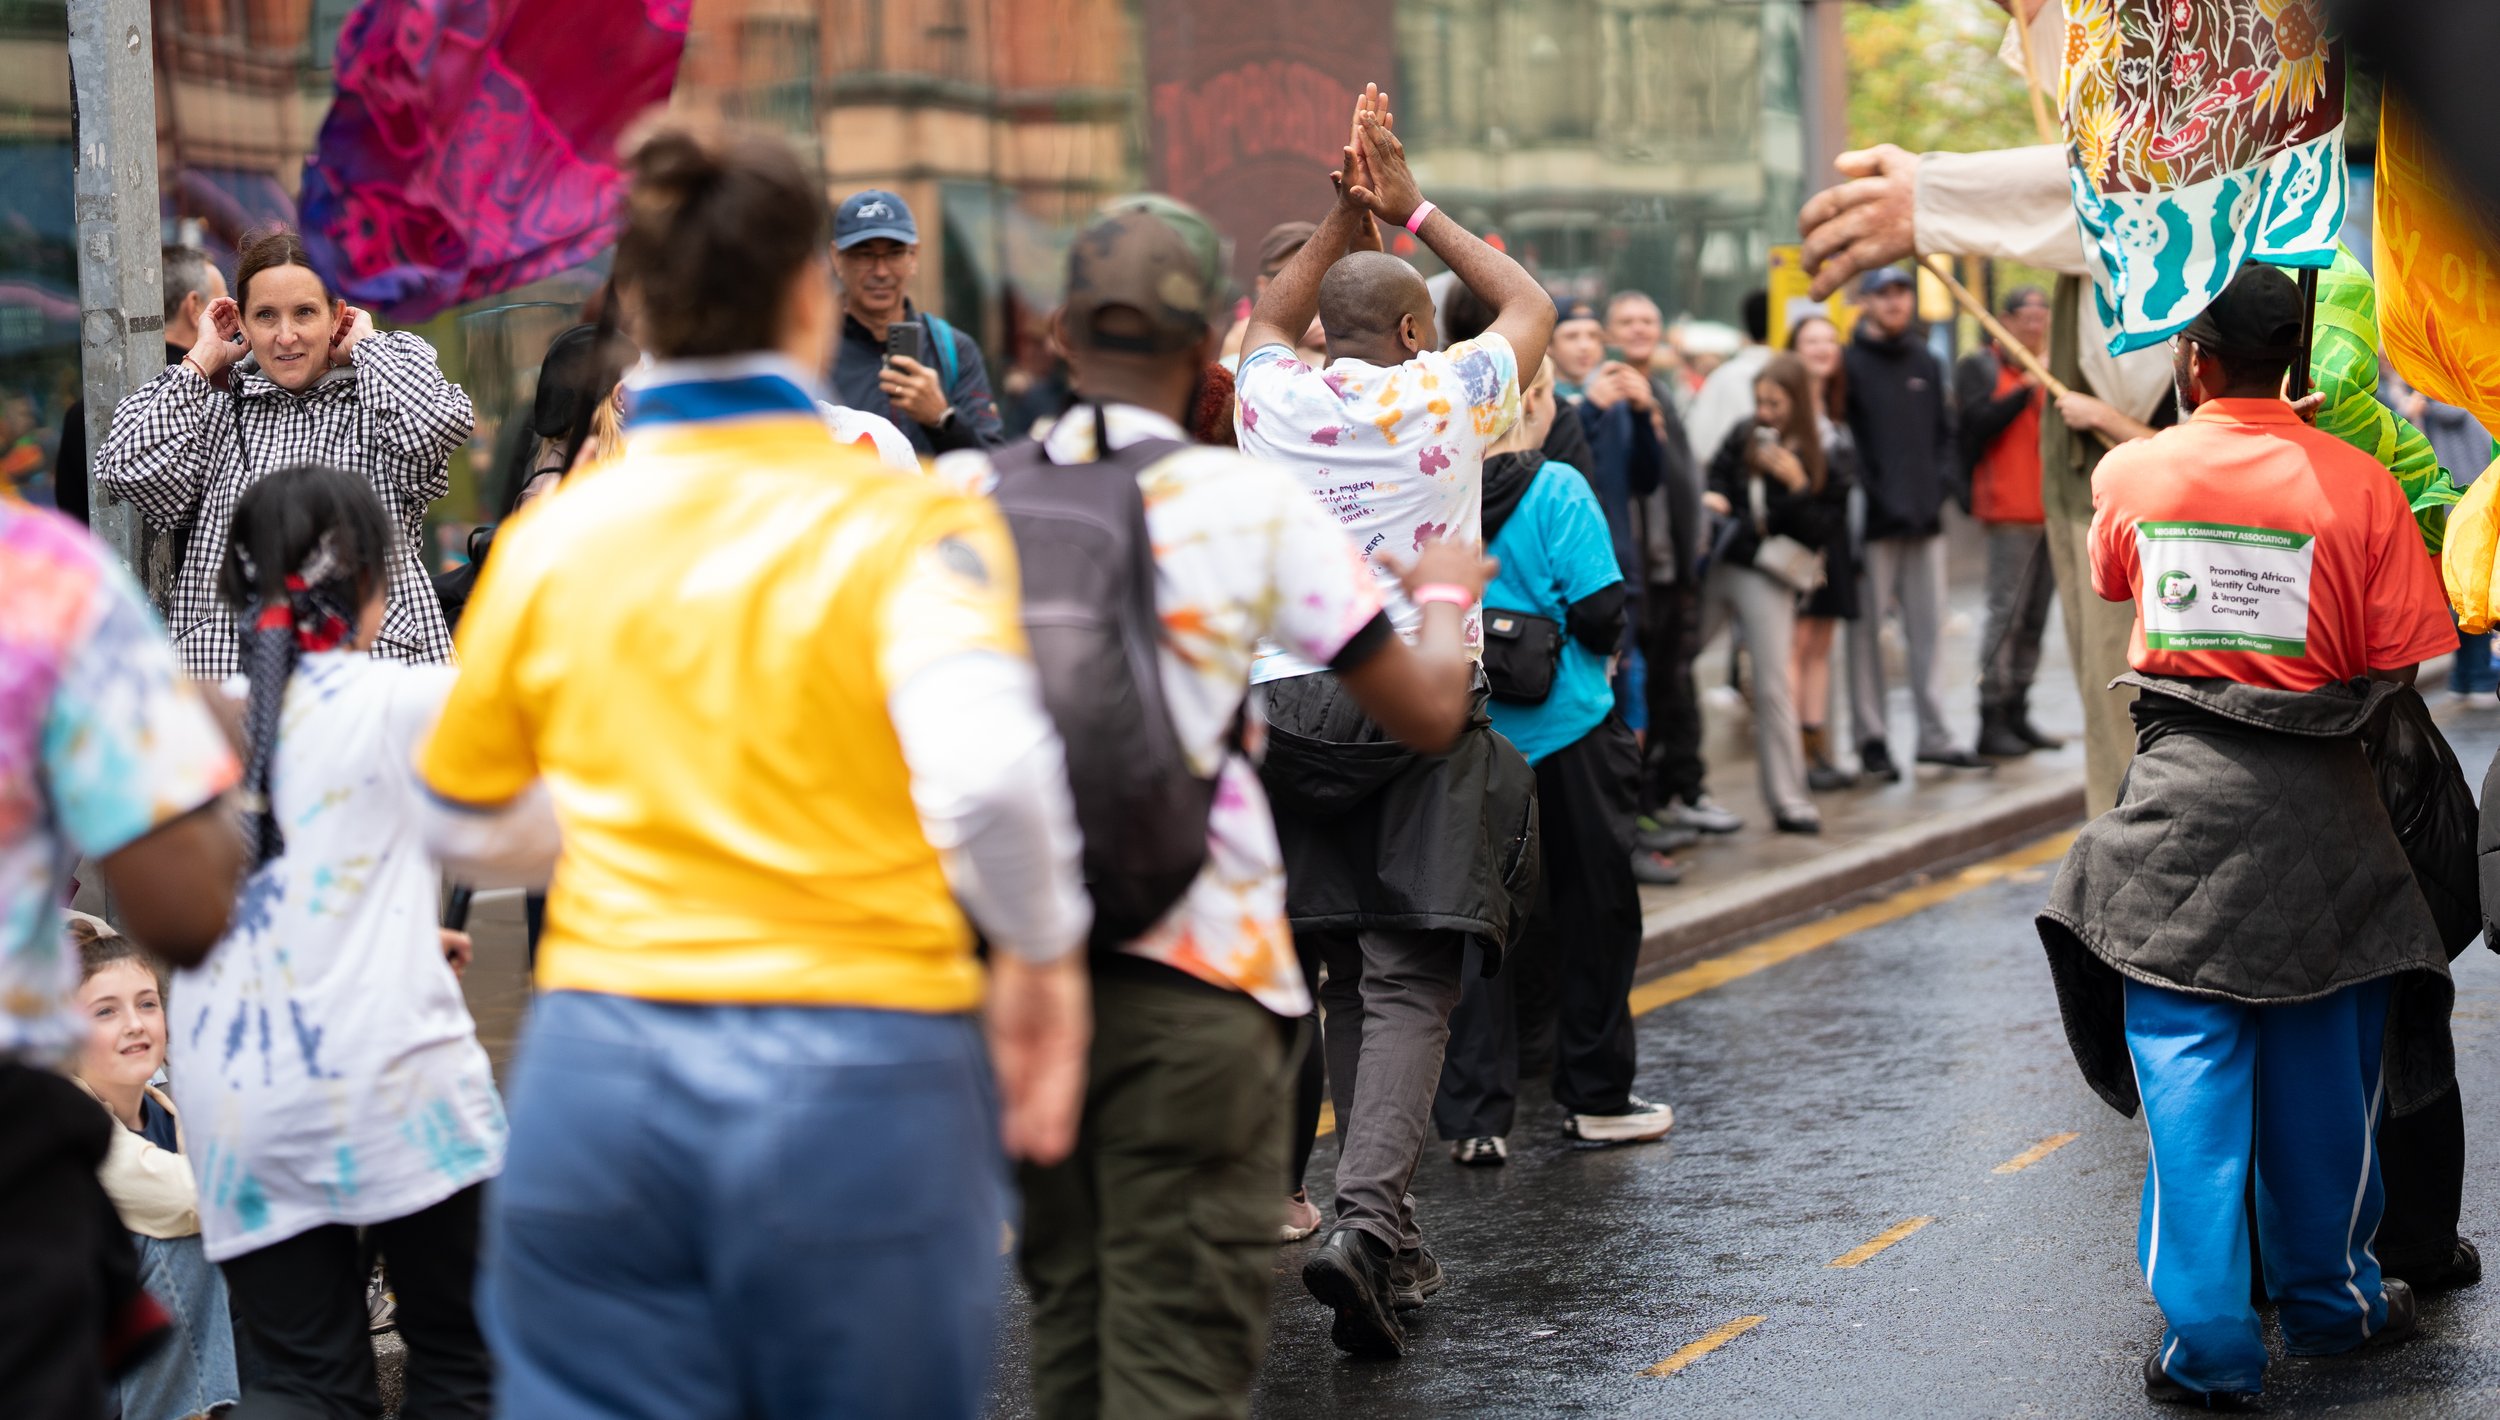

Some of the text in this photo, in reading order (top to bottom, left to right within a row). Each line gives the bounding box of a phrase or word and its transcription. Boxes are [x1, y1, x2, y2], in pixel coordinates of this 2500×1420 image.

[1339, 481, 1375, 493] mystery
[2154, 528, 2291, 545] NIGERIA COMMUNITY ASSOCIATION
[1360, 532, 1385, 563] EVERY
[2209, 566, 2296, 583] Promoting African
[2211, 579, 2280, 595] Identity Culture
[2212, 592, 2219, 600] &
[2211, 605, 2259, 619] Community
[2168, 637, 2189, 647] Kindly
[2191, 637, 2220, 646] Support
[2221, 637, 2236, 645] Our
